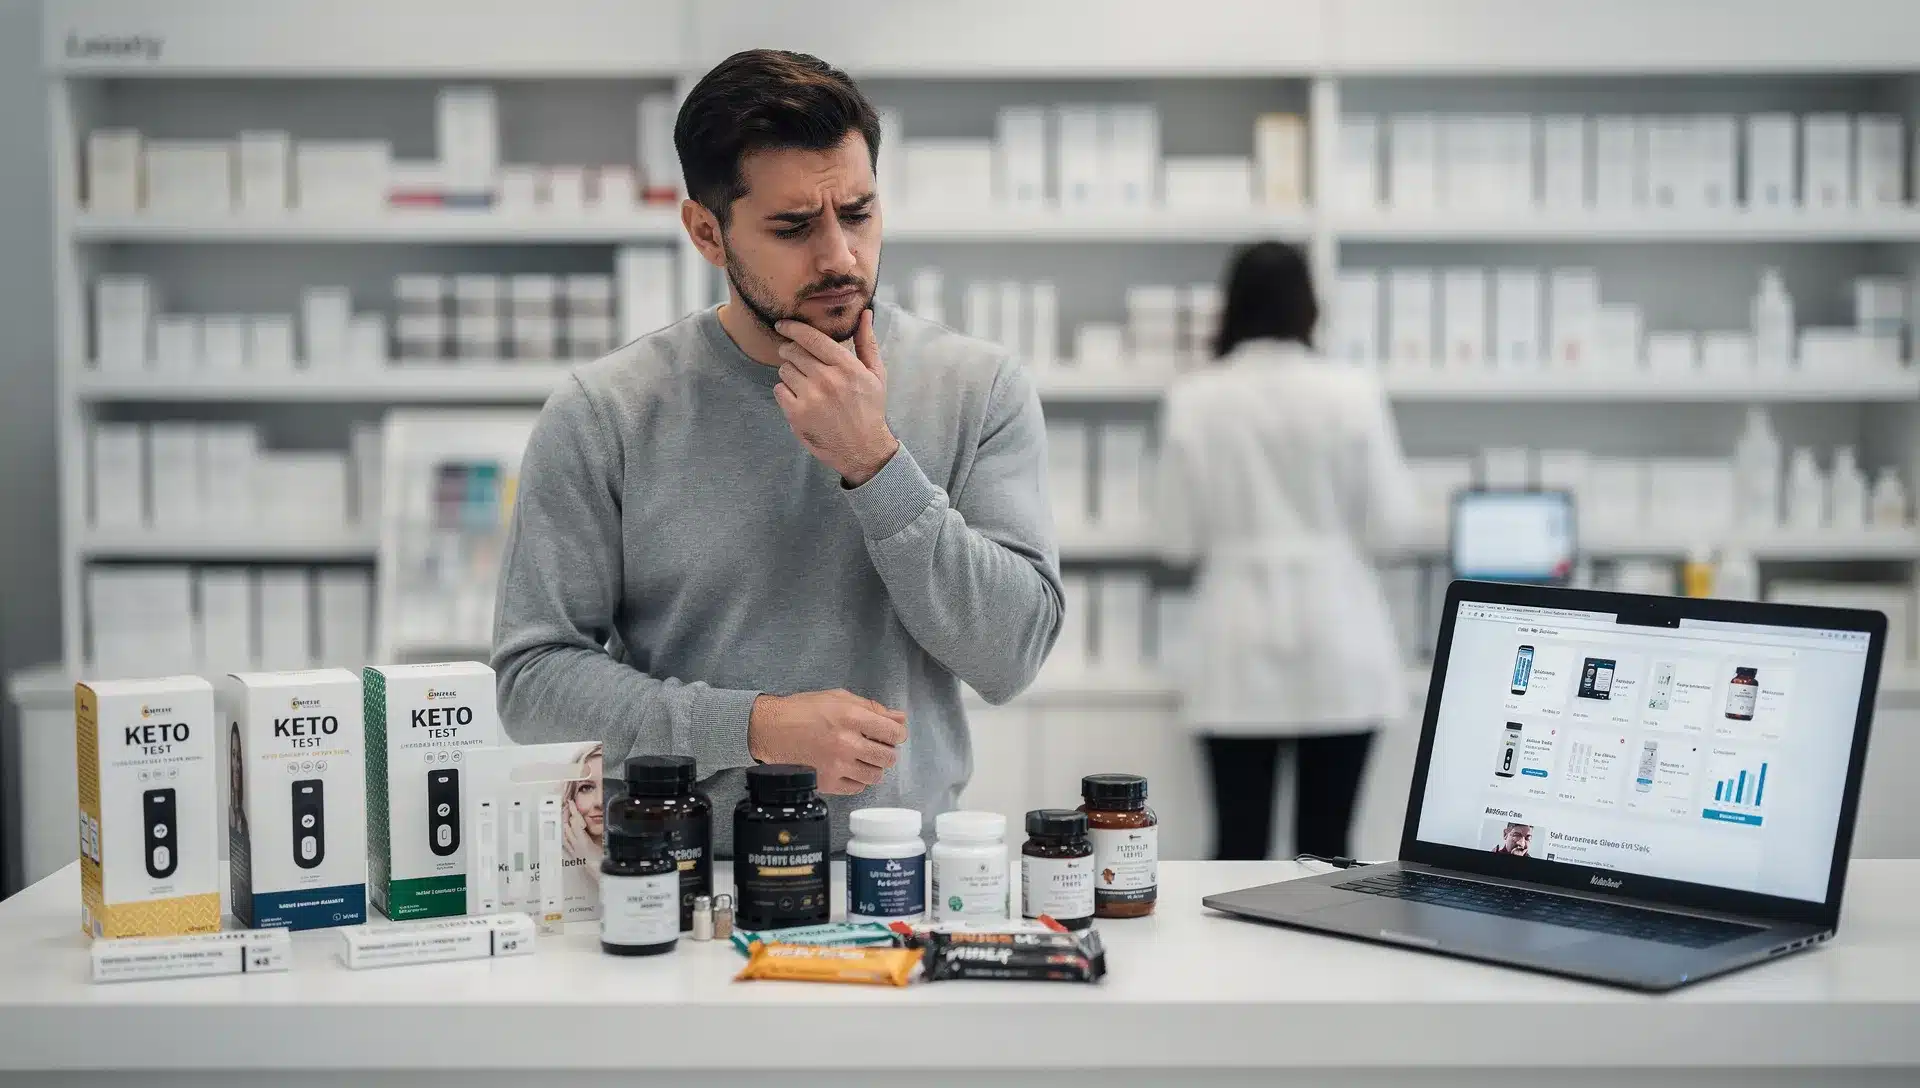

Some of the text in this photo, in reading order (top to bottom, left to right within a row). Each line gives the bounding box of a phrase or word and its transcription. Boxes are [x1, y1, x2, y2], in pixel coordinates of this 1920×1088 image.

[411, 707, 473, 728] KETO
[125, 722, 190, 745] KETO
[274, 716, 338, 737] KETO
[428, 728, 458, 739] TEST
[142, 744, 173, 756] TEST
[291, 737, 322, 748] TEST
